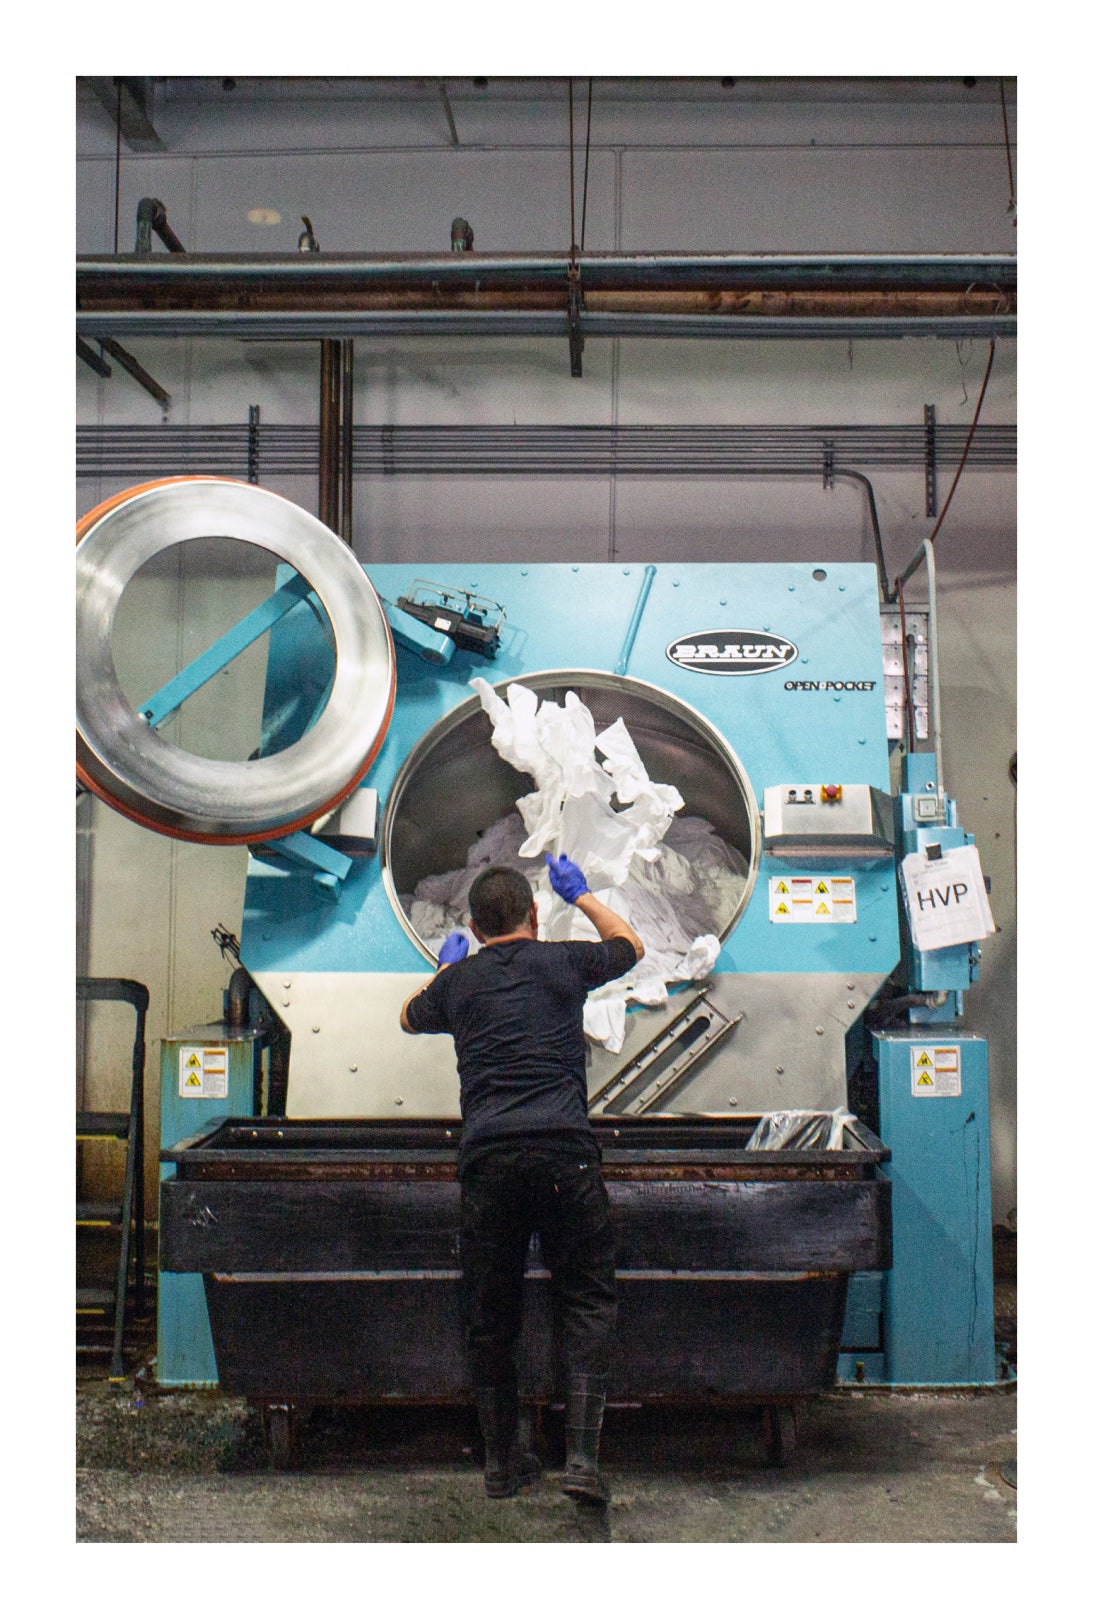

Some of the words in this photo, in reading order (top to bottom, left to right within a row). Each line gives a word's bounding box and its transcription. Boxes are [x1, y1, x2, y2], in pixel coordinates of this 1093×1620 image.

[673, 644, 792, 659] BRAUN
[825, 680, 877, 691] POCKET
[917, 883, 968, 911] HVP
